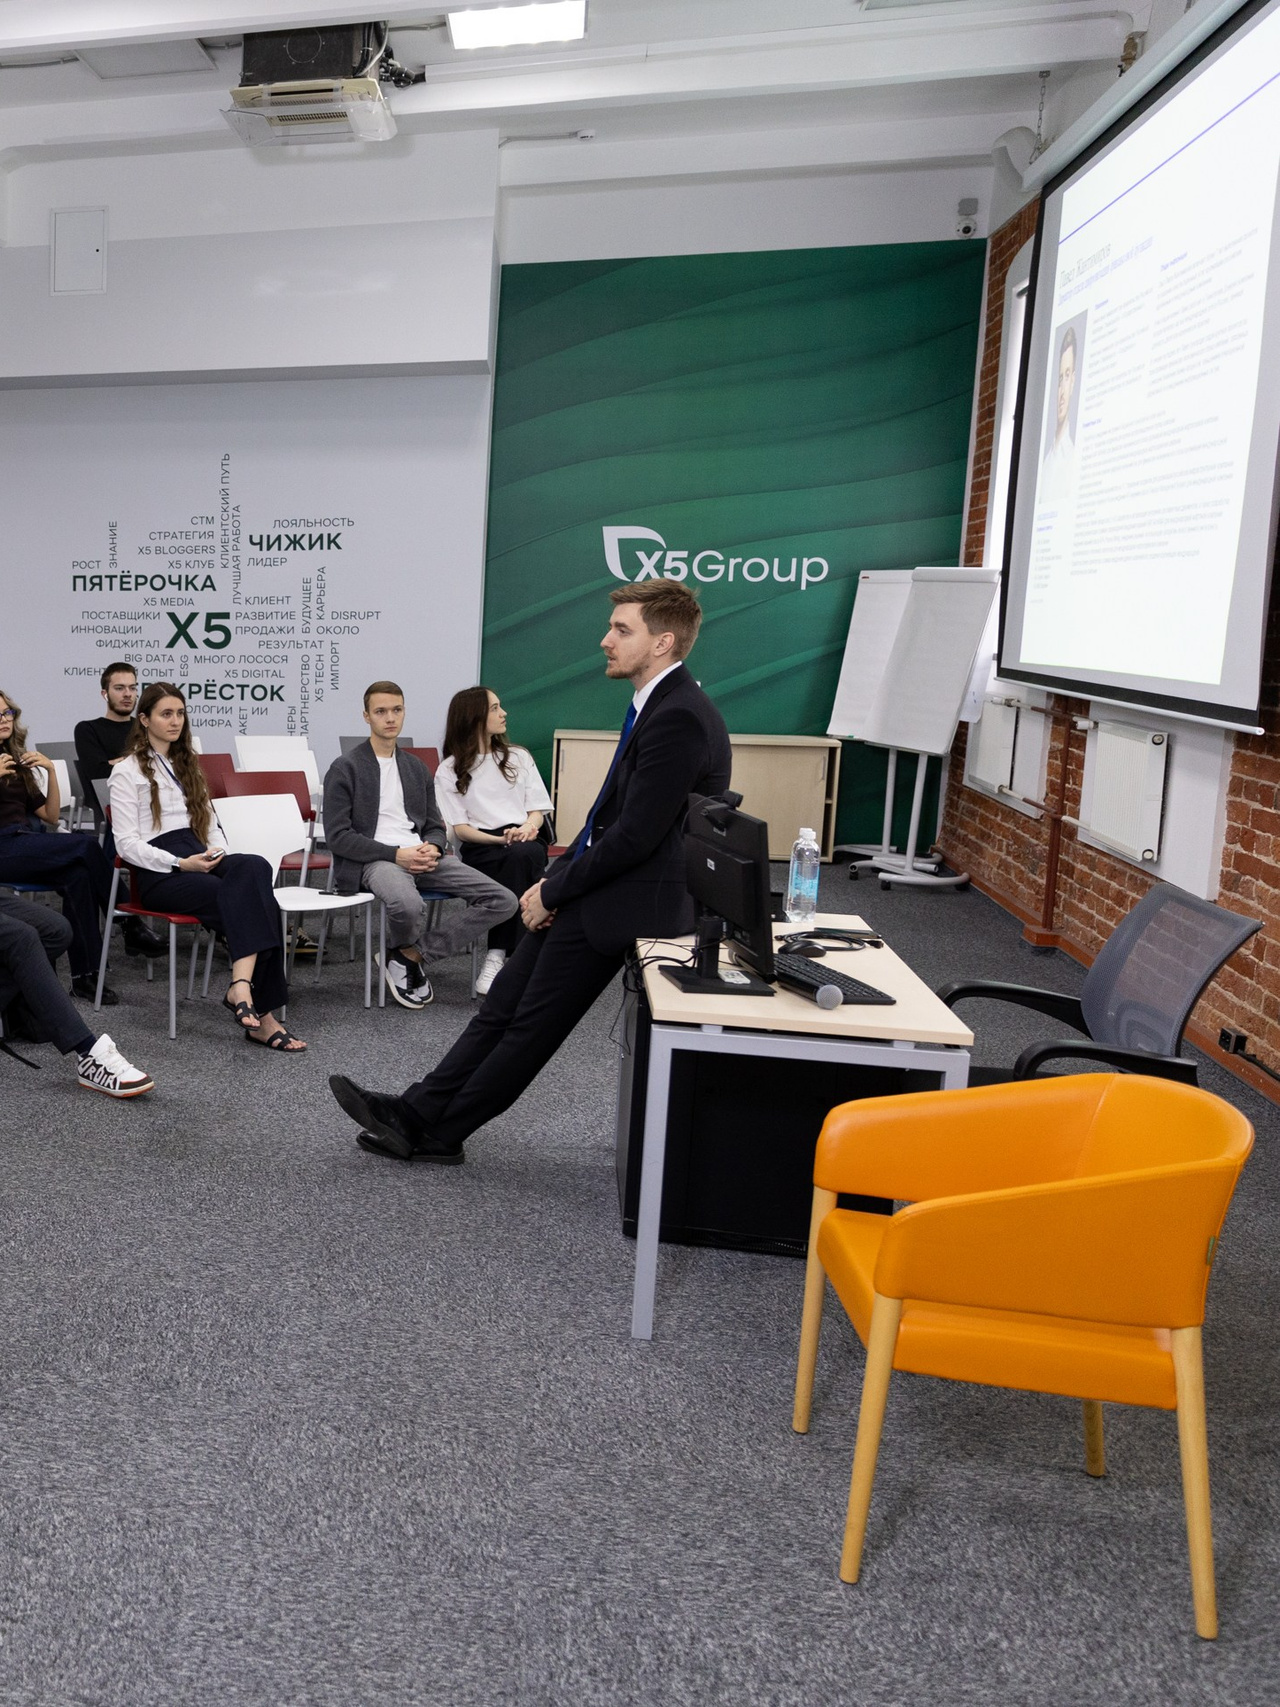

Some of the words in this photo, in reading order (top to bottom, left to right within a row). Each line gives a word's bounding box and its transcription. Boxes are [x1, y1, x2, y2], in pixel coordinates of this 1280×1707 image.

[221, 454, 230, 484] ПУТЬ
[191, 516, 214, 525] СТМ
[273, 518, 354, 528] ЛОЯЛЬНОСТЬ
[219, 488, 229, 568] КЛИЕНТСКИЙ
[232, 505, 240, 551] РАБОТА
[149, 531, 214, 540] СТРАТЕГИЯ
[109, 522, 117, 568] ЗНАНИЕ
[249, 532, 342, 551] ЧИЖИК
[155, 545, 215, 554] BLOGGERS
[72, 560, 101, 569] РОСТ
[185, 560, 214, 568] КЛУБ
[247, 557, 287, 567] ЛИДЕР
[634, 550, 829, 590] X5Group
[73, 570, 217, 592] ПЯТЁРОЧКА
[232, 555, 241, 605] ЛУЧШАЯ
[316, 566, 326, 620] КАРЬЕРА
[161, 598, 194, 606] MEDIA
[245, 596, 291, 605] КЛИЕНТ
[302, 578, 312, 633] БУДУЩЕЕ
[82, 611, 160, 621] ПОСТАВЩИКИ
[235, 611, 296, 620] РАЗВИТИЕ
[331, 611, 381, 620] DISRUPT
[72, 625, 142, 635] ИННОВАЦИИ
[165, 612, 232, 650] X5
[235, 626, 294, 635] ПРОДАЖИ
[316, 626, 359, 635] ОКОЛО
[96, 639, 159, 649] ФИДЖИТАЛ
[259, 640, 324, 649] РЕЗУЛЬТАТ
[124, 654, 143, 664] BIG
[146, 654, 174, 663] DATA
[194, 655, 235, 664] МНОГО
[238, 655, 288, 664] ЛОСОСЯ
[180, 655, 188, 676] ESG
[315, 654, 324, 684] TECH
[331, 640, 339, 690] ИМПОРТ
[142, 668, 174, 677] ОПЫТ
[242, 669, 285, 678] DIGITAL
[300, 655, 310, 736] ПАРТНЕРСТВО
[186, 704, 233, 715] ОЛОГИИ
[252, 707, 268, 715] ИИ
[192, 719, 232, 728] ЦИФРА
[239, 707, 247, 735] АКЕТ
[287, 706, 296, 736] НЕРЫ
